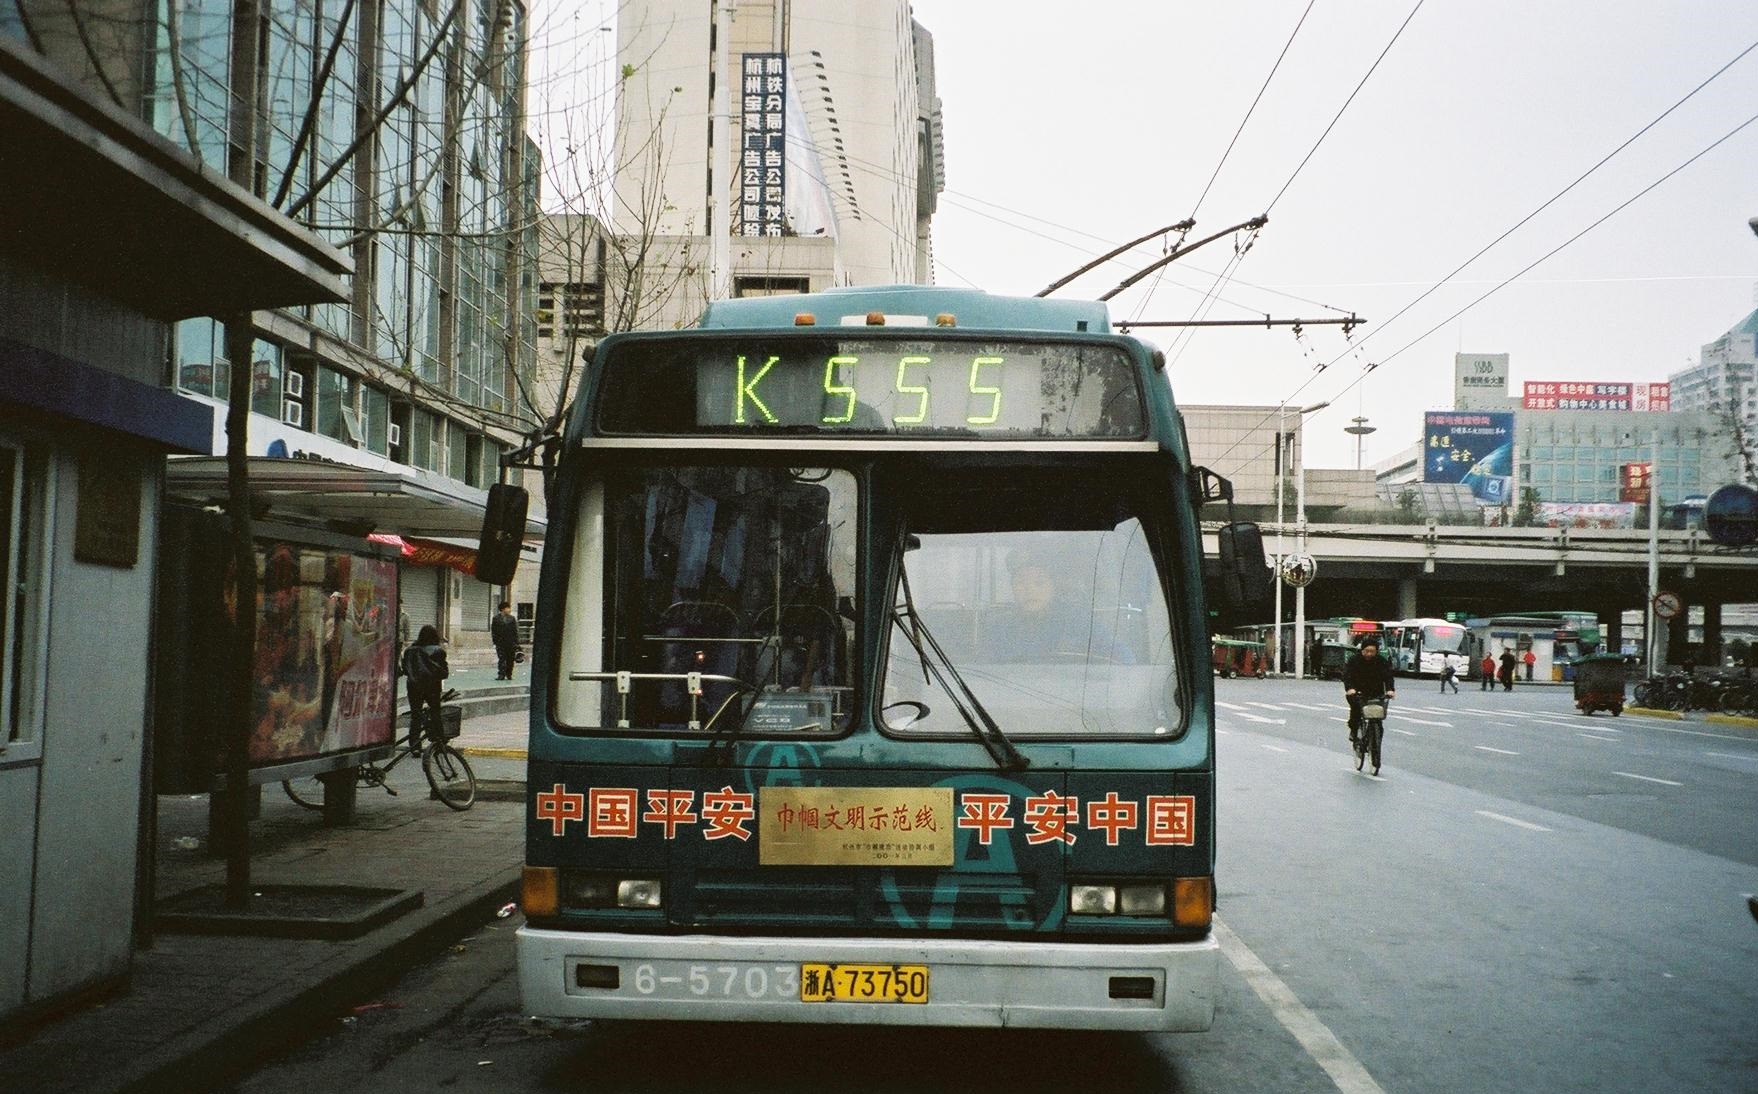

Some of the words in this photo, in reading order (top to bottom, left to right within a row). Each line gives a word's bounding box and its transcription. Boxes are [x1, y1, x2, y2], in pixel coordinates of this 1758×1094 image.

[536, 783, 755, 842] 中国平安
[776, 802, 937, 832] 巾帼文明示范线
[958, 789, 1196, 847] 平安中国
[635, 963, 799, 998] 6-5703
